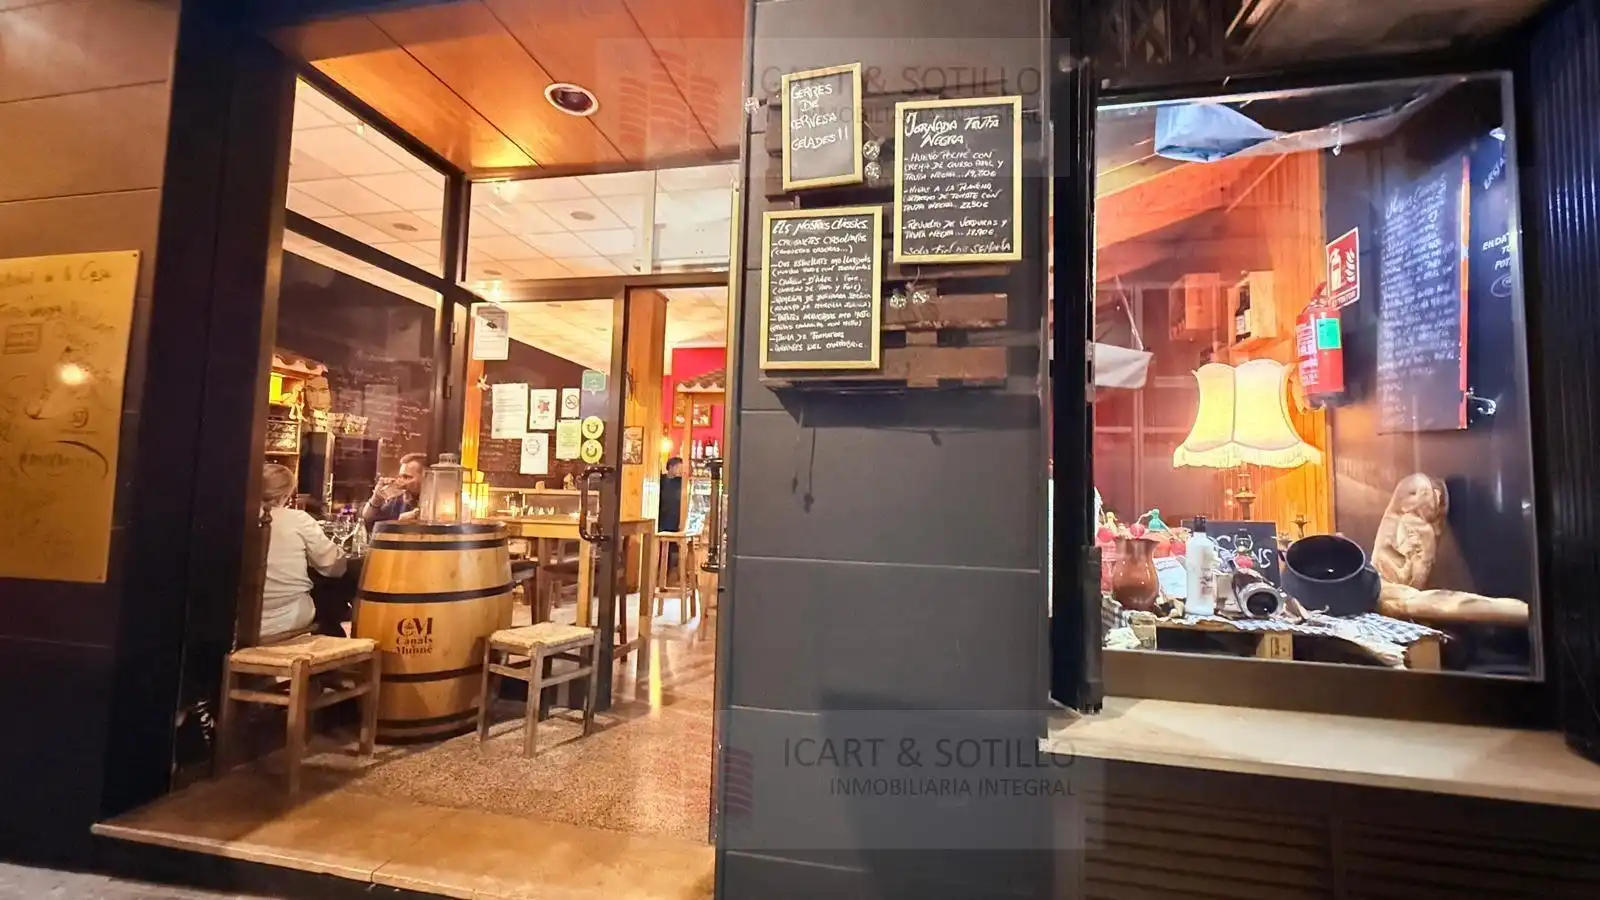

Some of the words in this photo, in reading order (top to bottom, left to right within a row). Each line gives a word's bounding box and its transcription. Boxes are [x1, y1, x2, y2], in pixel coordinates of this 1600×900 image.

[791, 83, 833, 99] GERRES
[800, 99, 819, 112] DE
[920, 132, 964, 148] NEGRA
[972, 151, 994, 160] CON
[396, 636, 433, 645] Canals
